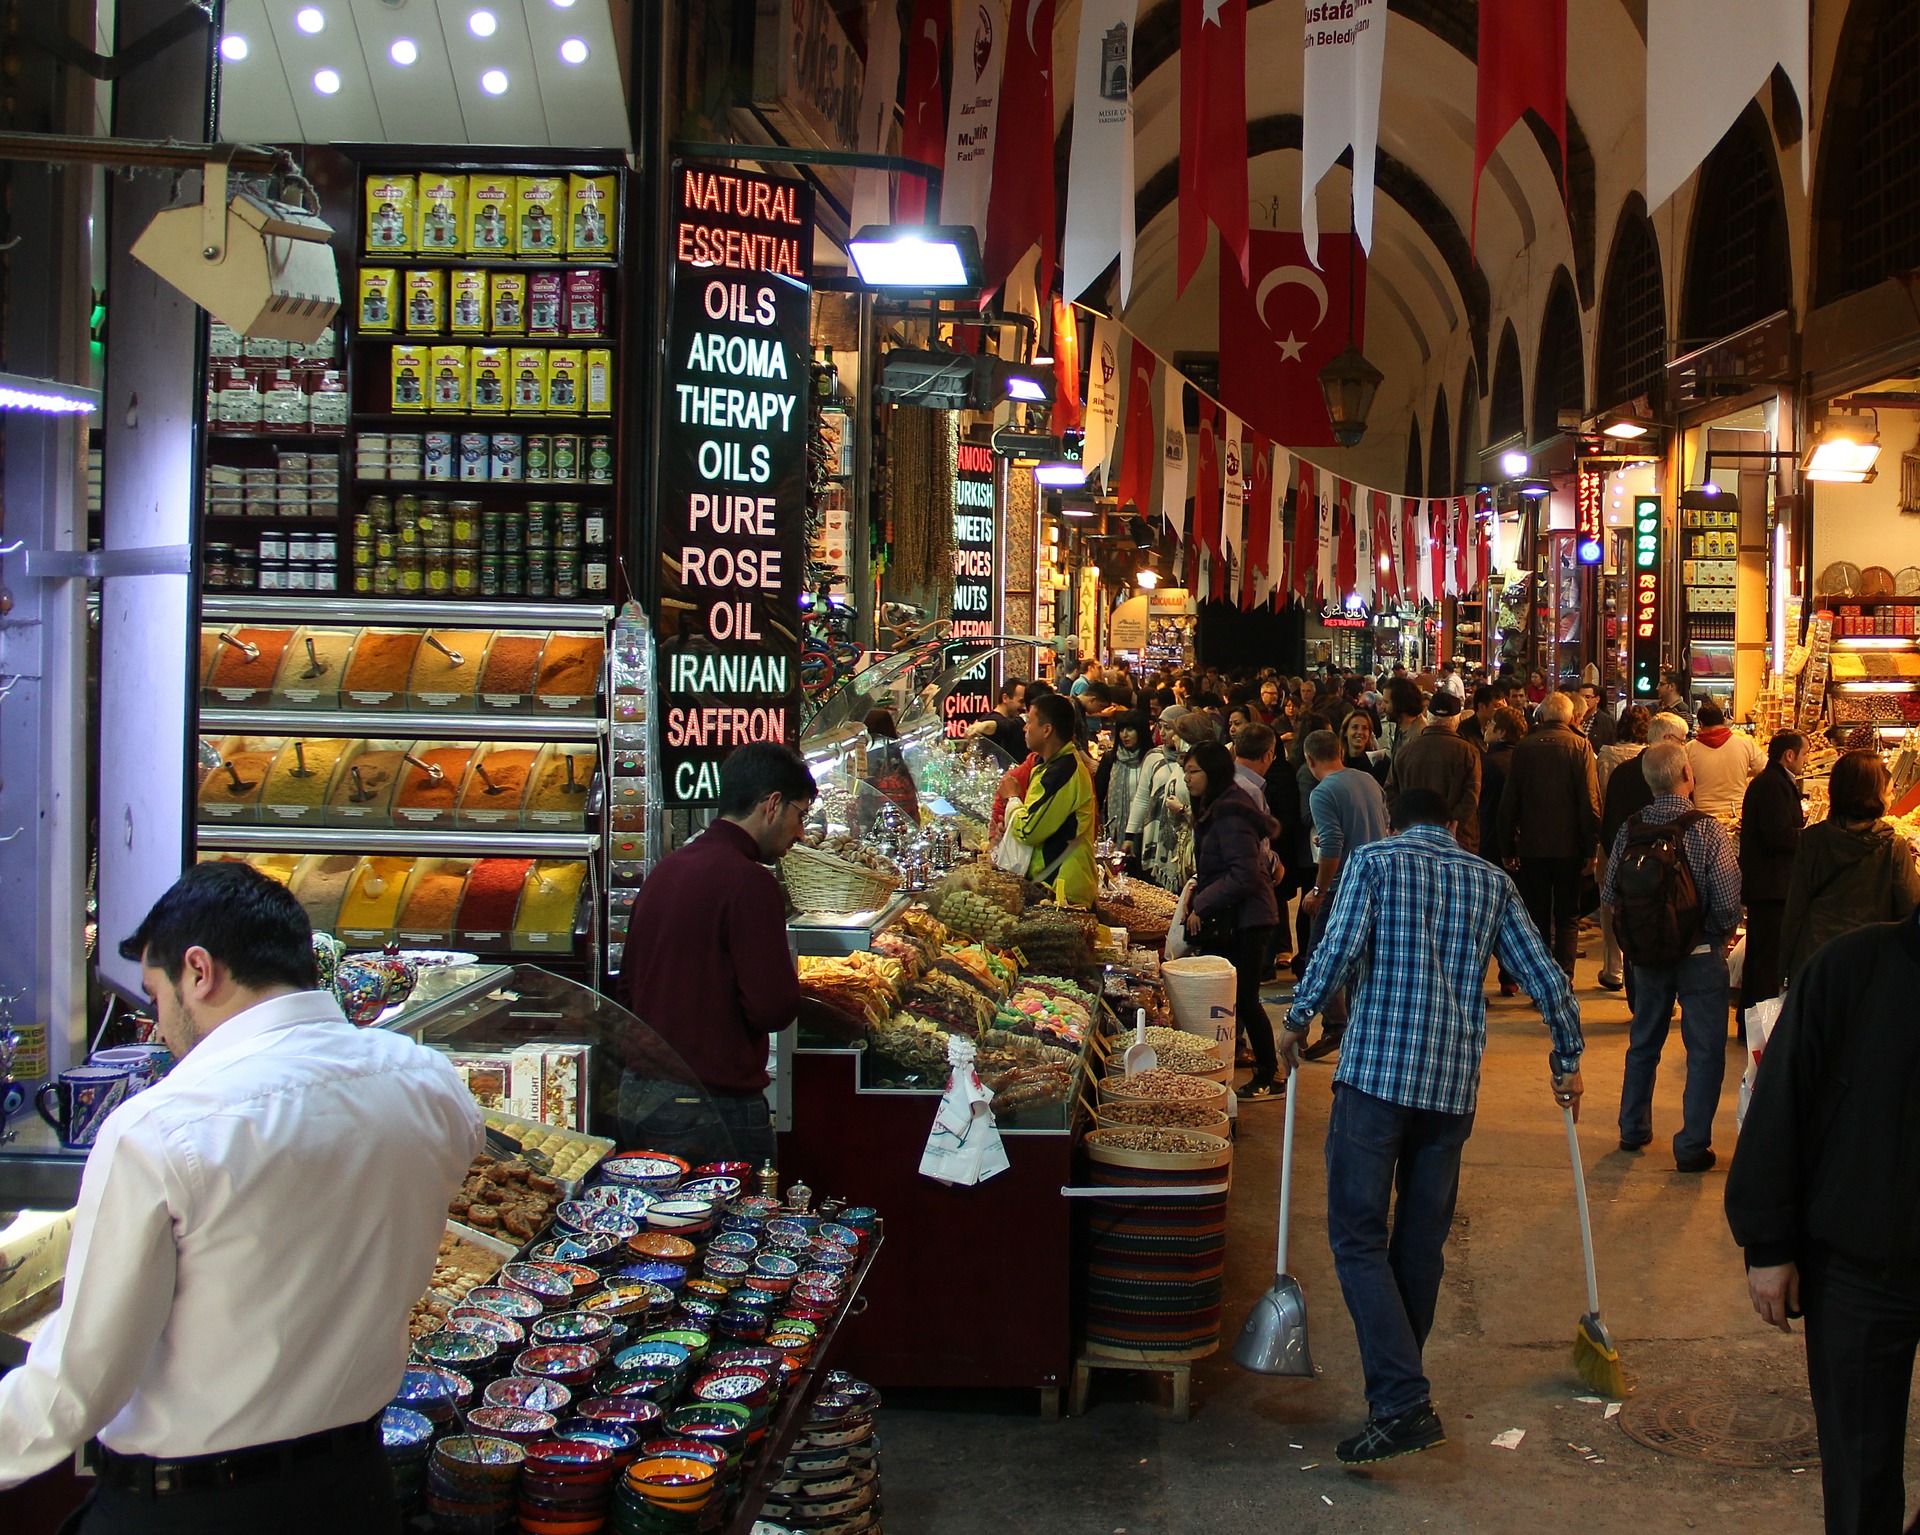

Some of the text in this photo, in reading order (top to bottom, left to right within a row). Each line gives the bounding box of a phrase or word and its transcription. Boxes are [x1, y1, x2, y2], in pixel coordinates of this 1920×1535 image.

[1306, 1, 1354, 25] ustafa
[684, 169, 802, 226] NATURAL
[678, 223, 805, 277] ESSENTIAL
[704, 280, 777, 327] OILS
[687, 332, 788, 381] AROMA
[676, 383, 797, 433] THERAPY
[698, 439, 771, 484] OILS
[957, 445, 993, 473] AMOUS
[689, 493, 776, 537] PURE
[1639, 502, 1657, 567] PURE
[681, 546, 782, 589] ROSE
[953, 585, 988, 611] NUTS
[1081, 566, 1093, 651] HAYAT
[1639, 574, 1656, 637] ROSE
[709, 600, 762, 641] OIL
[1324, 619, 1366, 628] RESTAURANT
[669, 653, 786, 693] IRANIAN
[667, 706, 786, 747] SAFFRON
[945, 692, 990, 718] ÇİKİTA
[1216, 1024, 1236, 1042] İNC
[531, 1075, 540, 1113] DELIGHT
